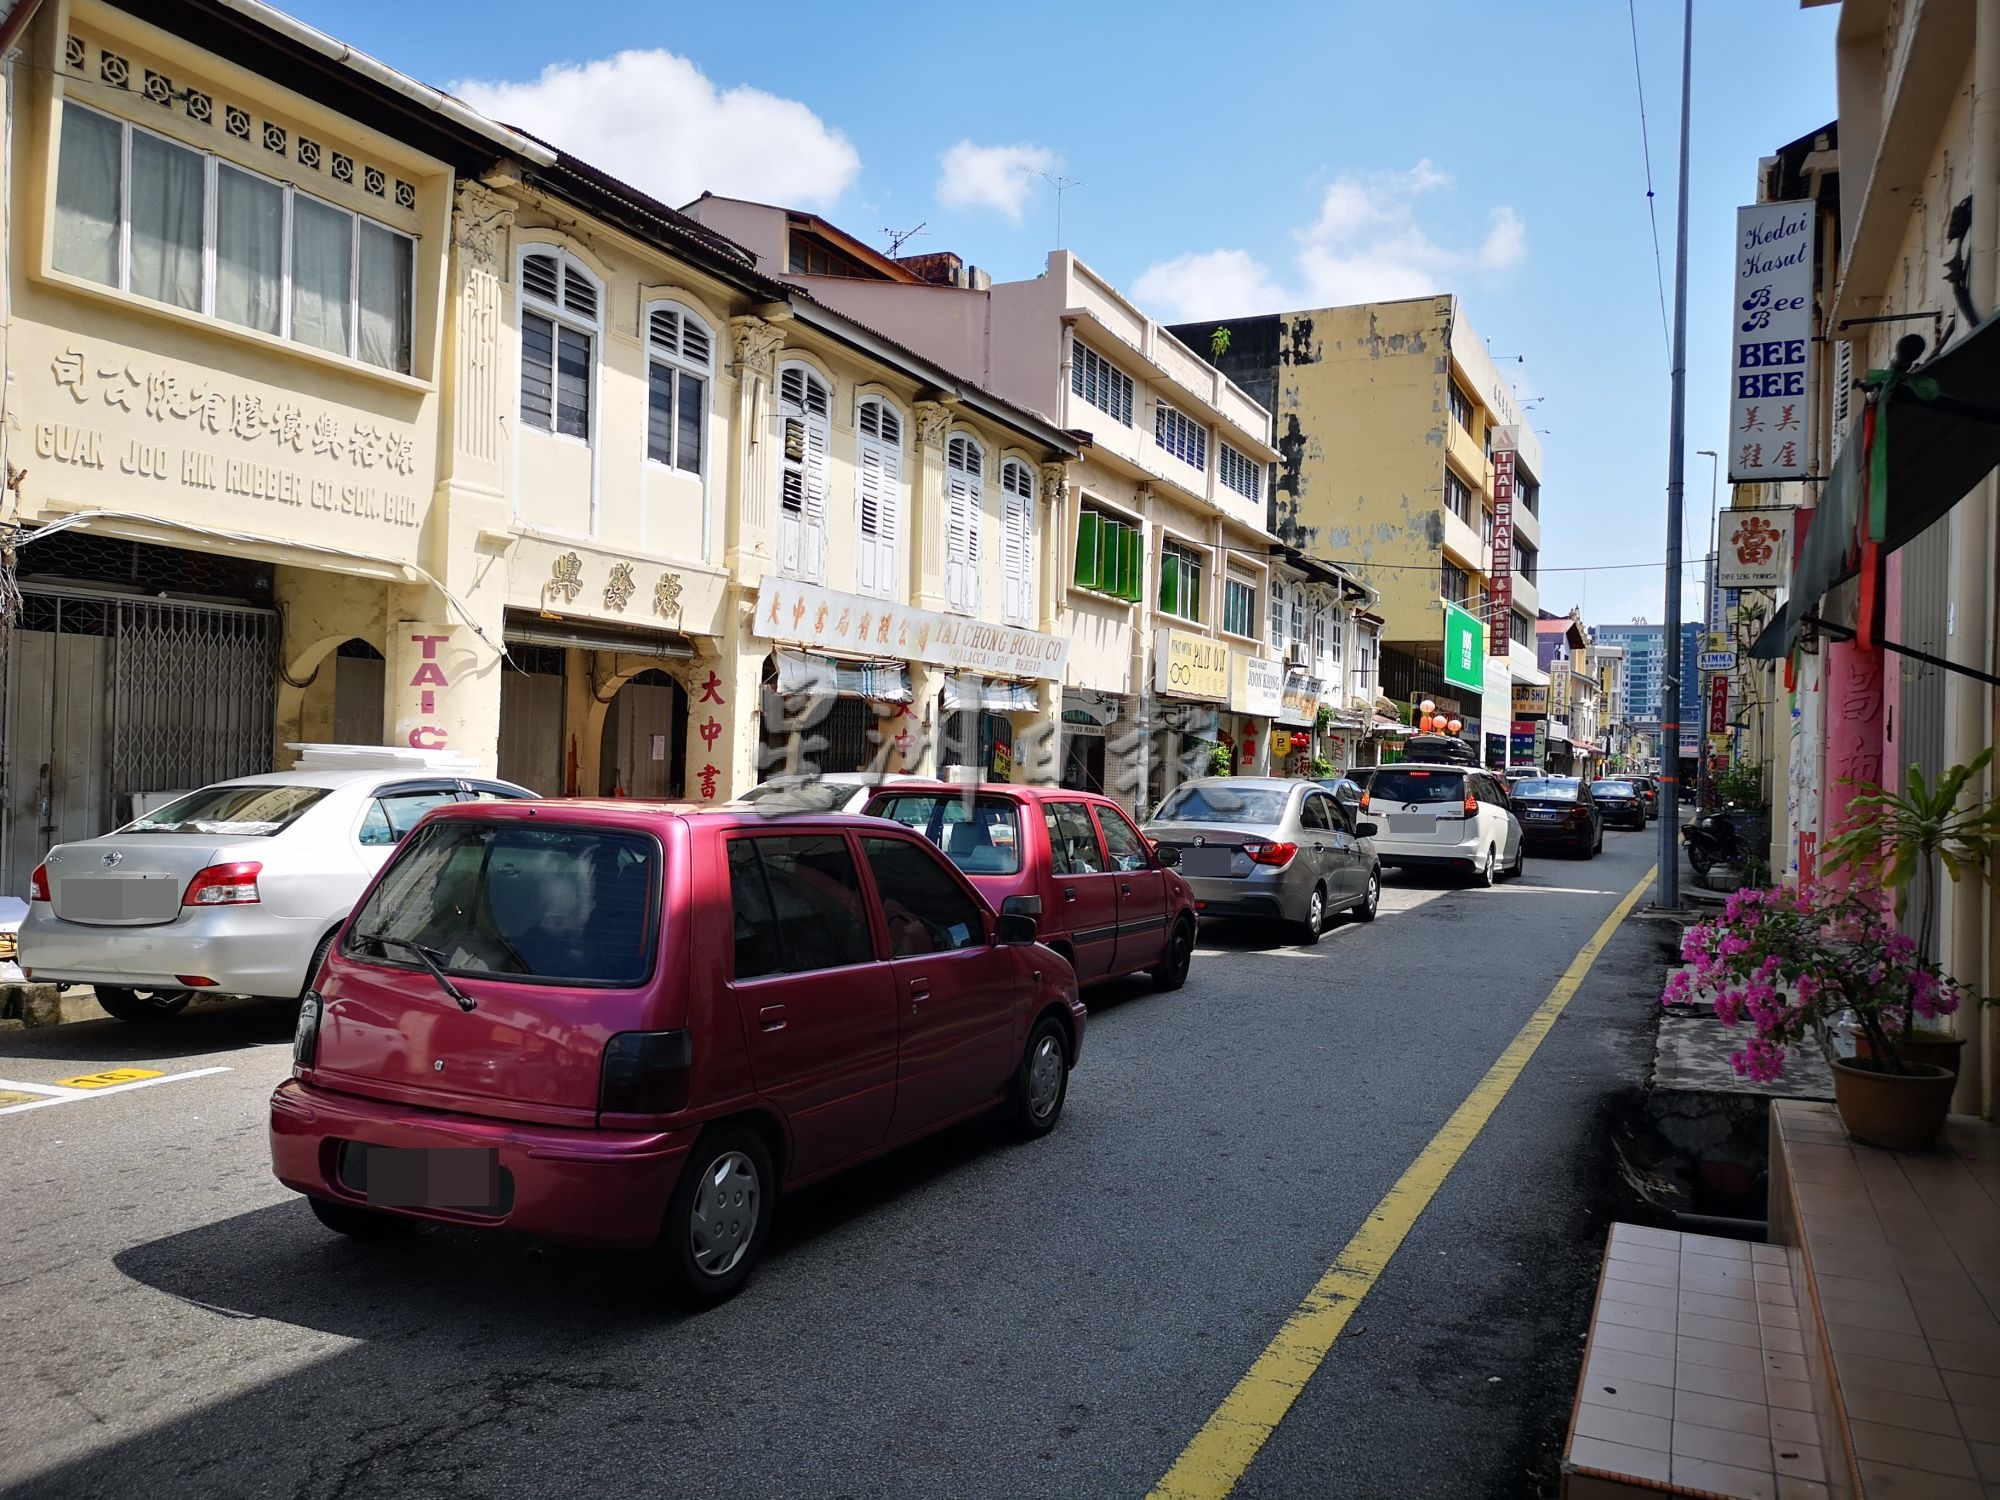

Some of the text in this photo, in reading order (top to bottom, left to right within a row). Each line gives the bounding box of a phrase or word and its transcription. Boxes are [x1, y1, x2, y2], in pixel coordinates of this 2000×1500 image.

[1745, 212, 1807, 249] Kedai
[1743, 242, 1807, 278] Kasut
[1739, 339, 1805, 368] BEE
[1739, 371, 1804, 399] BEE
[1740, 404, 1800, 433] 美美
[36, 424, 104, 470] GUAN
[120, 440, 168, 480] JOO
[182, 450, 216, 490] HIN
[226, 458, 303, 506] RUBBER
[384, 492, 420, 528] BHD.
[1496, 451, 1511, 497] THAI
[1495, 503, 1510, 549] SHAN
[935, 620, 961, 645] TAI
[963, 624, 1009, 652] CHONG
[1045, 640, 1061, 662] CO
[1701, 653, 1733, 663] KIMMA
[1713, 678, 1725, 731] PAJAK
[697, 670, 725, 799] 大中書
